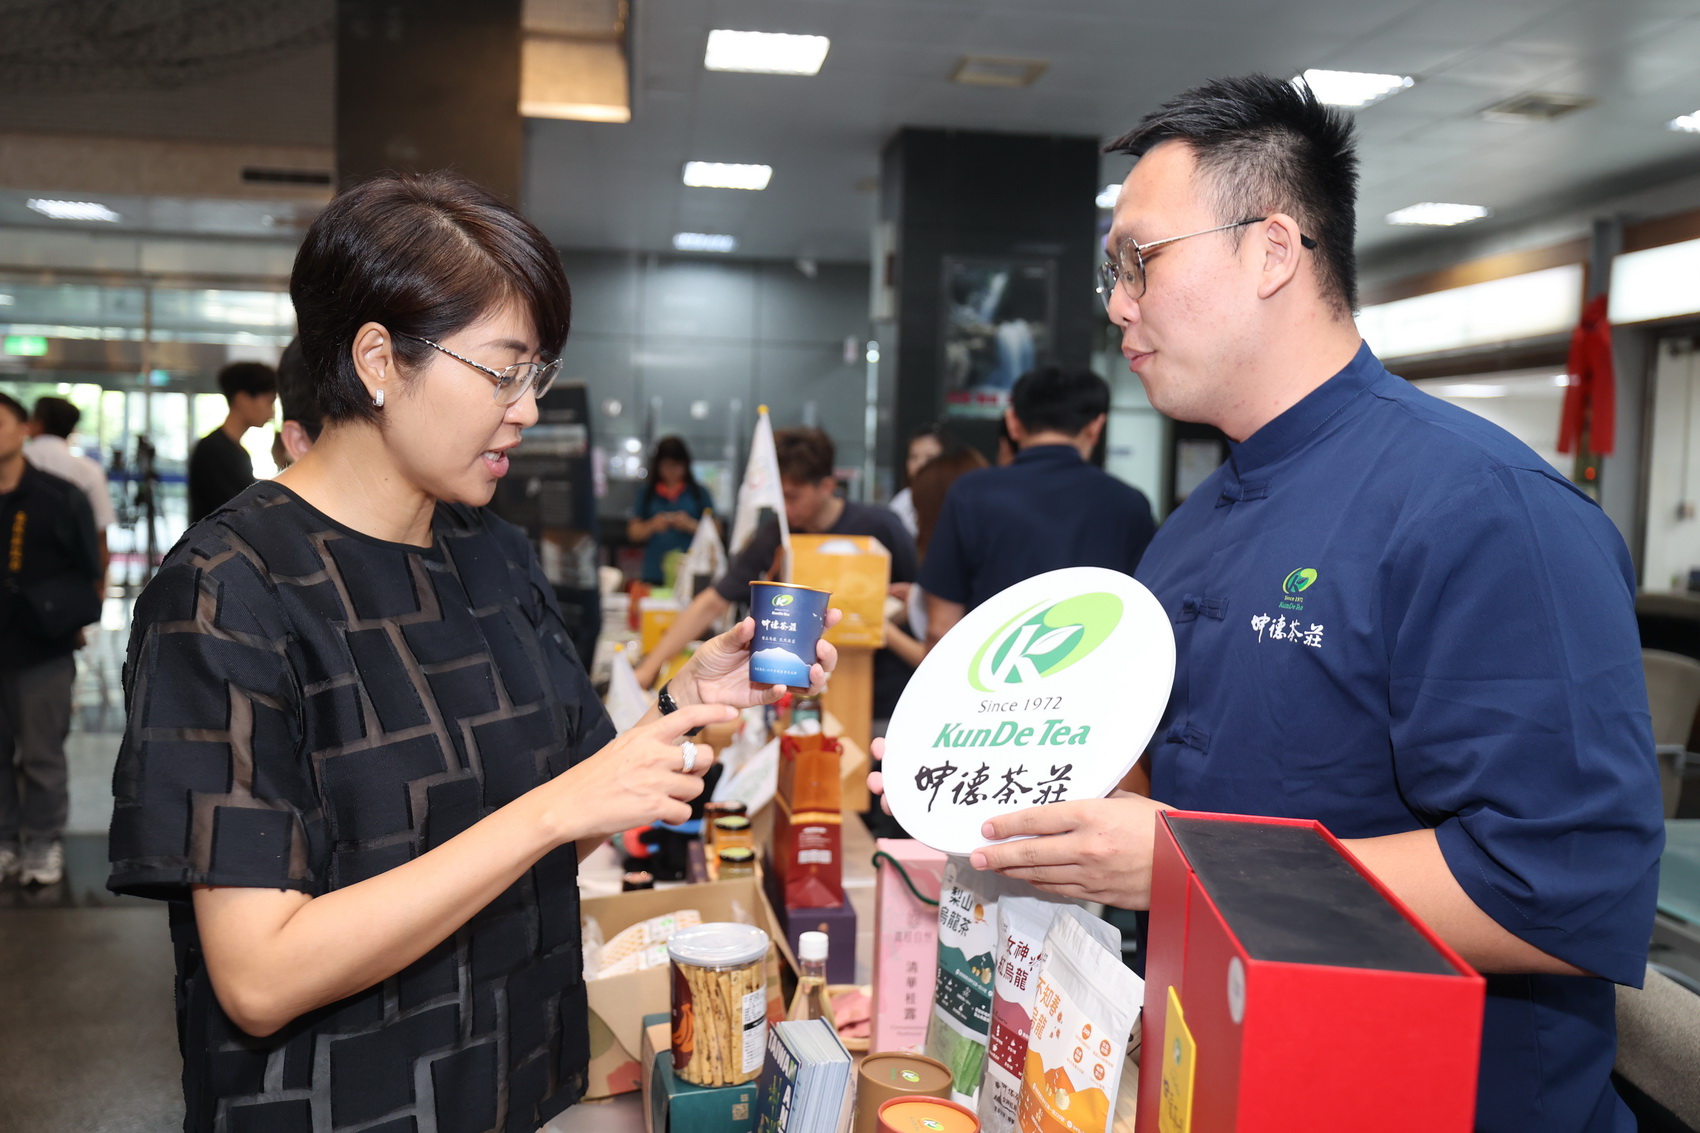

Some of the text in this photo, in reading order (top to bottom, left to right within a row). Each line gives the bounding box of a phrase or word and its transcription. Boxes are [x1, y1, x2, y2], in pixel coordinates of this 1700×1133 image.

[977, 696, 1063, 713] Since 1972
[931, 718, 1092, 748] KunDe Tea
[949, 885, 974, 913] 梨山
[939, 906, 973, 938] 烏龍茶
[1006, 936, 1031, 962] 女神
